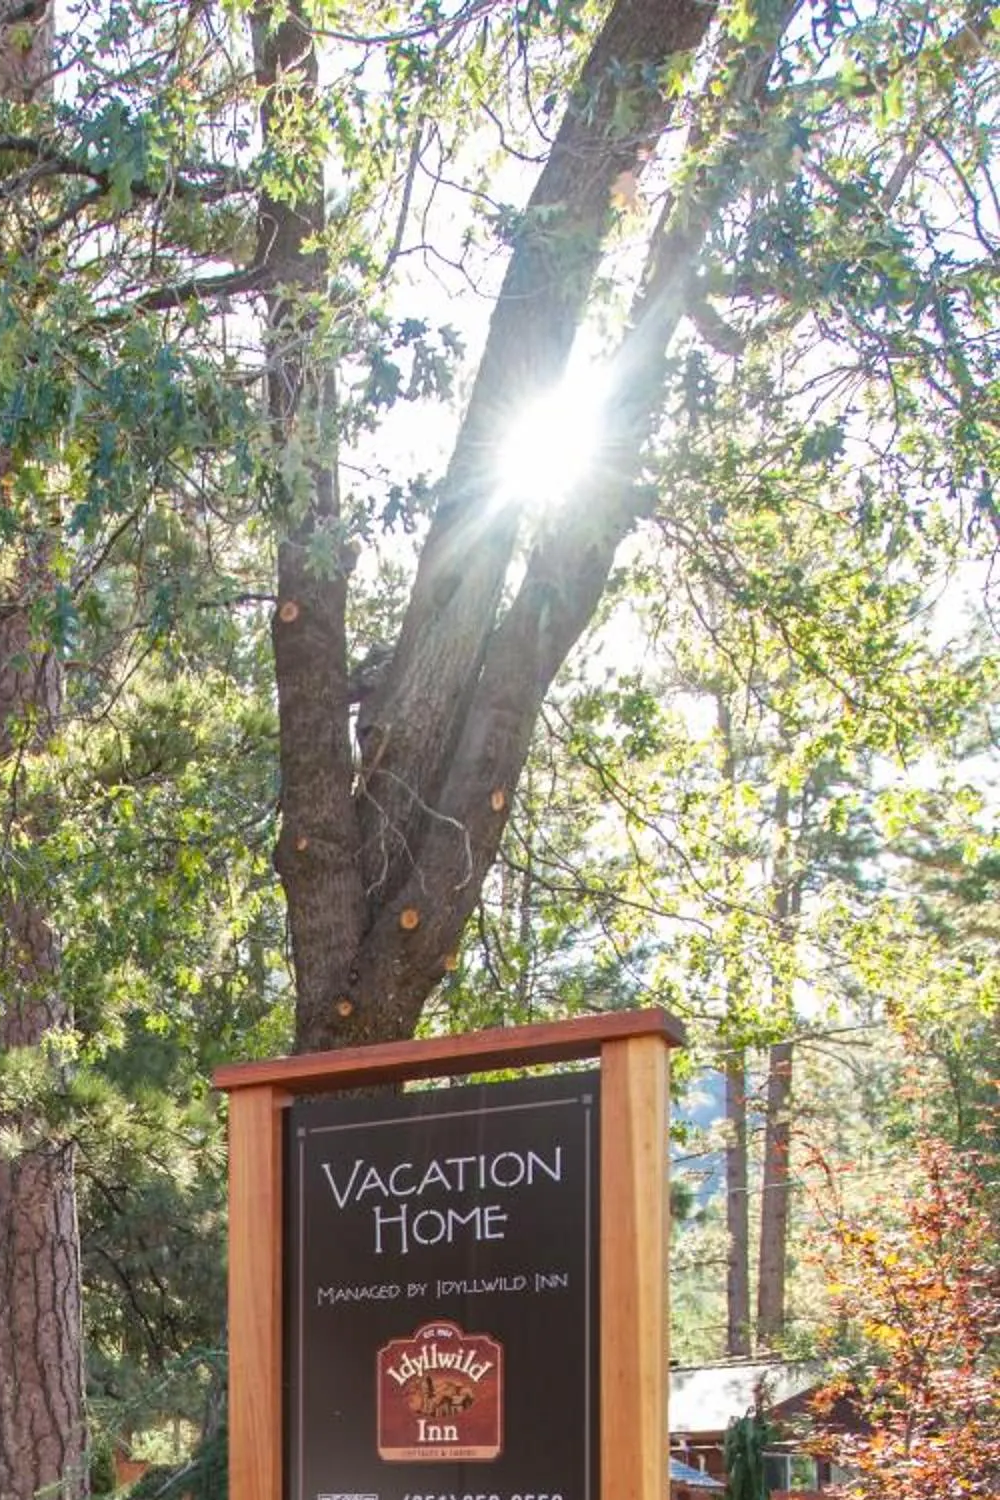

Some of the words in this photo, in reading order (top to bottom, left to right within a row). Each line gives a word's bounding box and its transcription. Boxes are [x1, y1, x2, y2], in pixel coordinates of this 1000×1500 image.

[321, 1146, 561, 1210] VACATION
[372, 1203, 508, 1255] HOME
[317, 1285, 401, 1305] MANAGED
[407, 1282, 428, 1299] BY
[436, 1276, 527, 1299] IDYLLWILD
[535, 1272, 569, 1293] INN
[387, 1343, 495, 1386] Idyllwild
[417, 1419, 460, 1442] Inn
